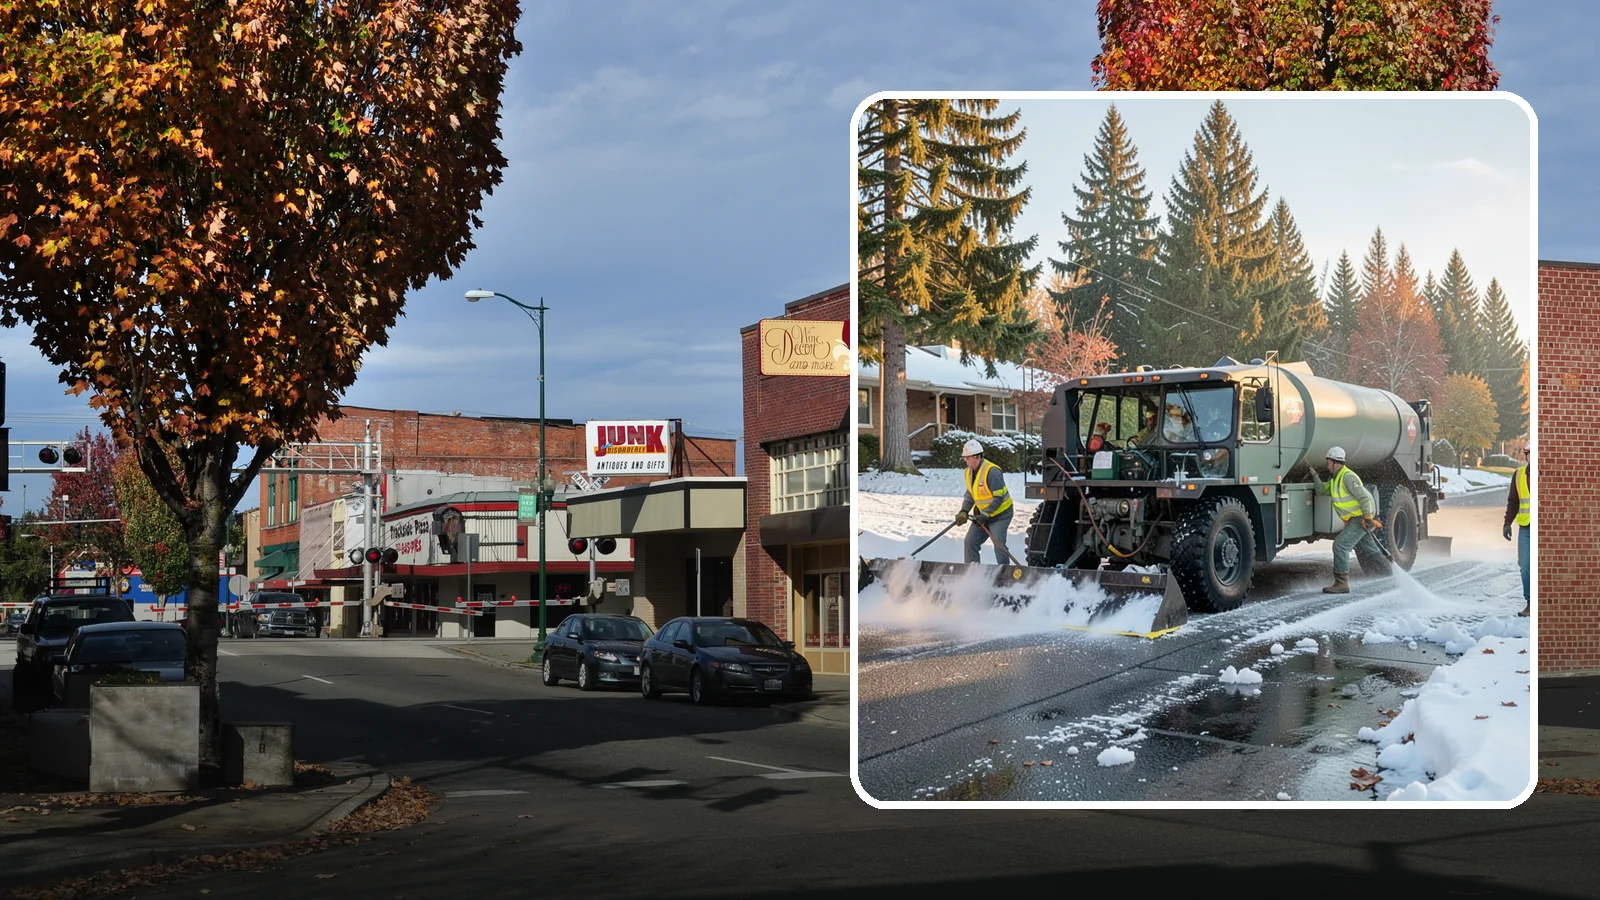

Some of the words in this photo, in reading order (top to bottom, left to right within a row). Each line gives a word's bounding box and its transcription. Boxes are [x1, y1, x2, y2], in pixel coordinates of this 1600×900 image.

[595, 425, 665, 457] JUNK
[607, 446, 645, 454] DISORDERLY
[596, 461, 628, 470] ANTIQUES
[631, 461, 643, 469] AND
[647, 460, 665, 469] GIFTS
[389, 521, 413, 540] Trackside
[414, 519, 429, 535] Pizza
